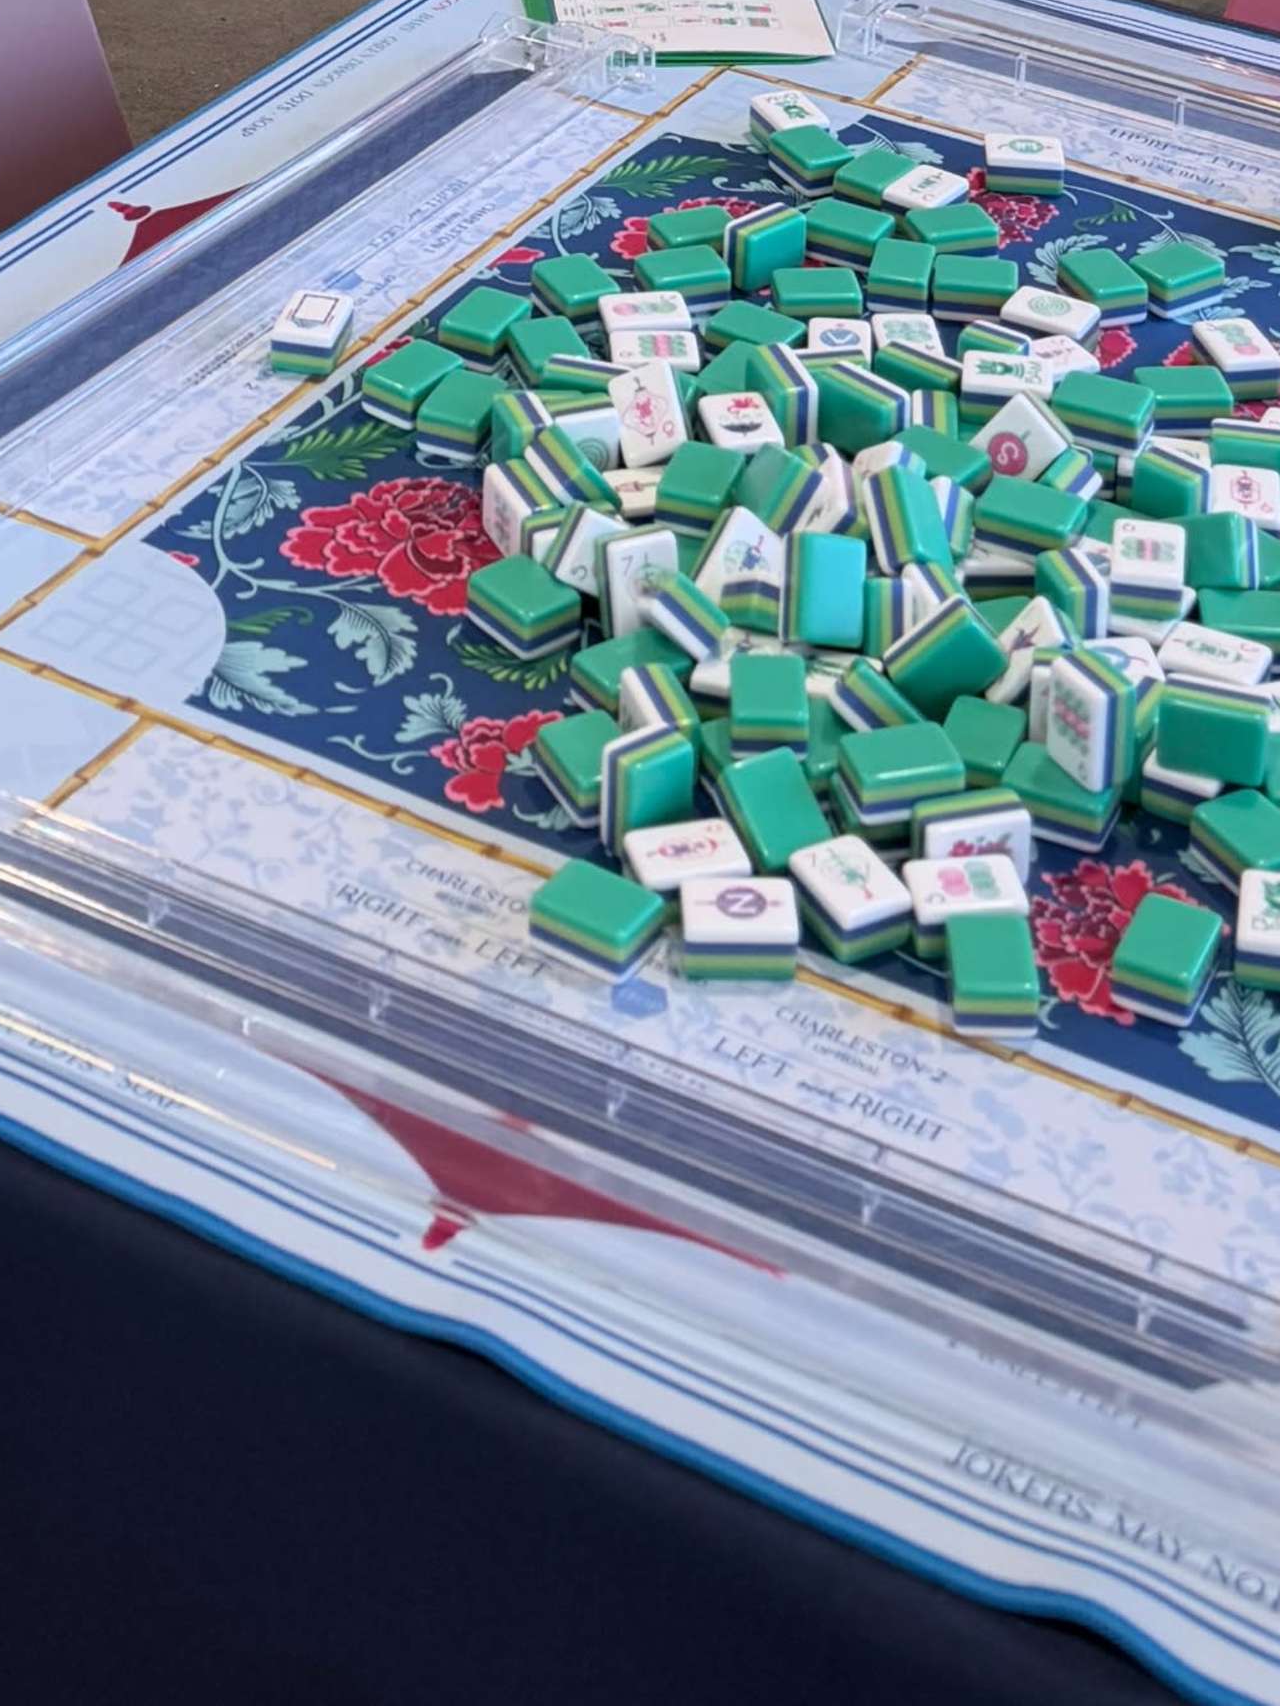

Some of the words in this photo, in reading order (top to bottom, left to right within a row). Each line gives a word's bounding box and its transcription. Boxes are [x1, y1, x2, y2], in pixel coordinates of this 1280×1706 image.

[336, 883, 422, 929] RIGHT
[474, 937, 556, 979] LEFT
[405, 858, 532, 915] CHARLESTO
[775, 1004, 930, 1074] CHARLESTON
[711, 1036, 793, 1079] LEFT
[848, 1091, 951, 1143] RIGHT
[945, 1439, 1097, 1528] JOKERS
[1109, 1512, 1191, 1566] MAY
